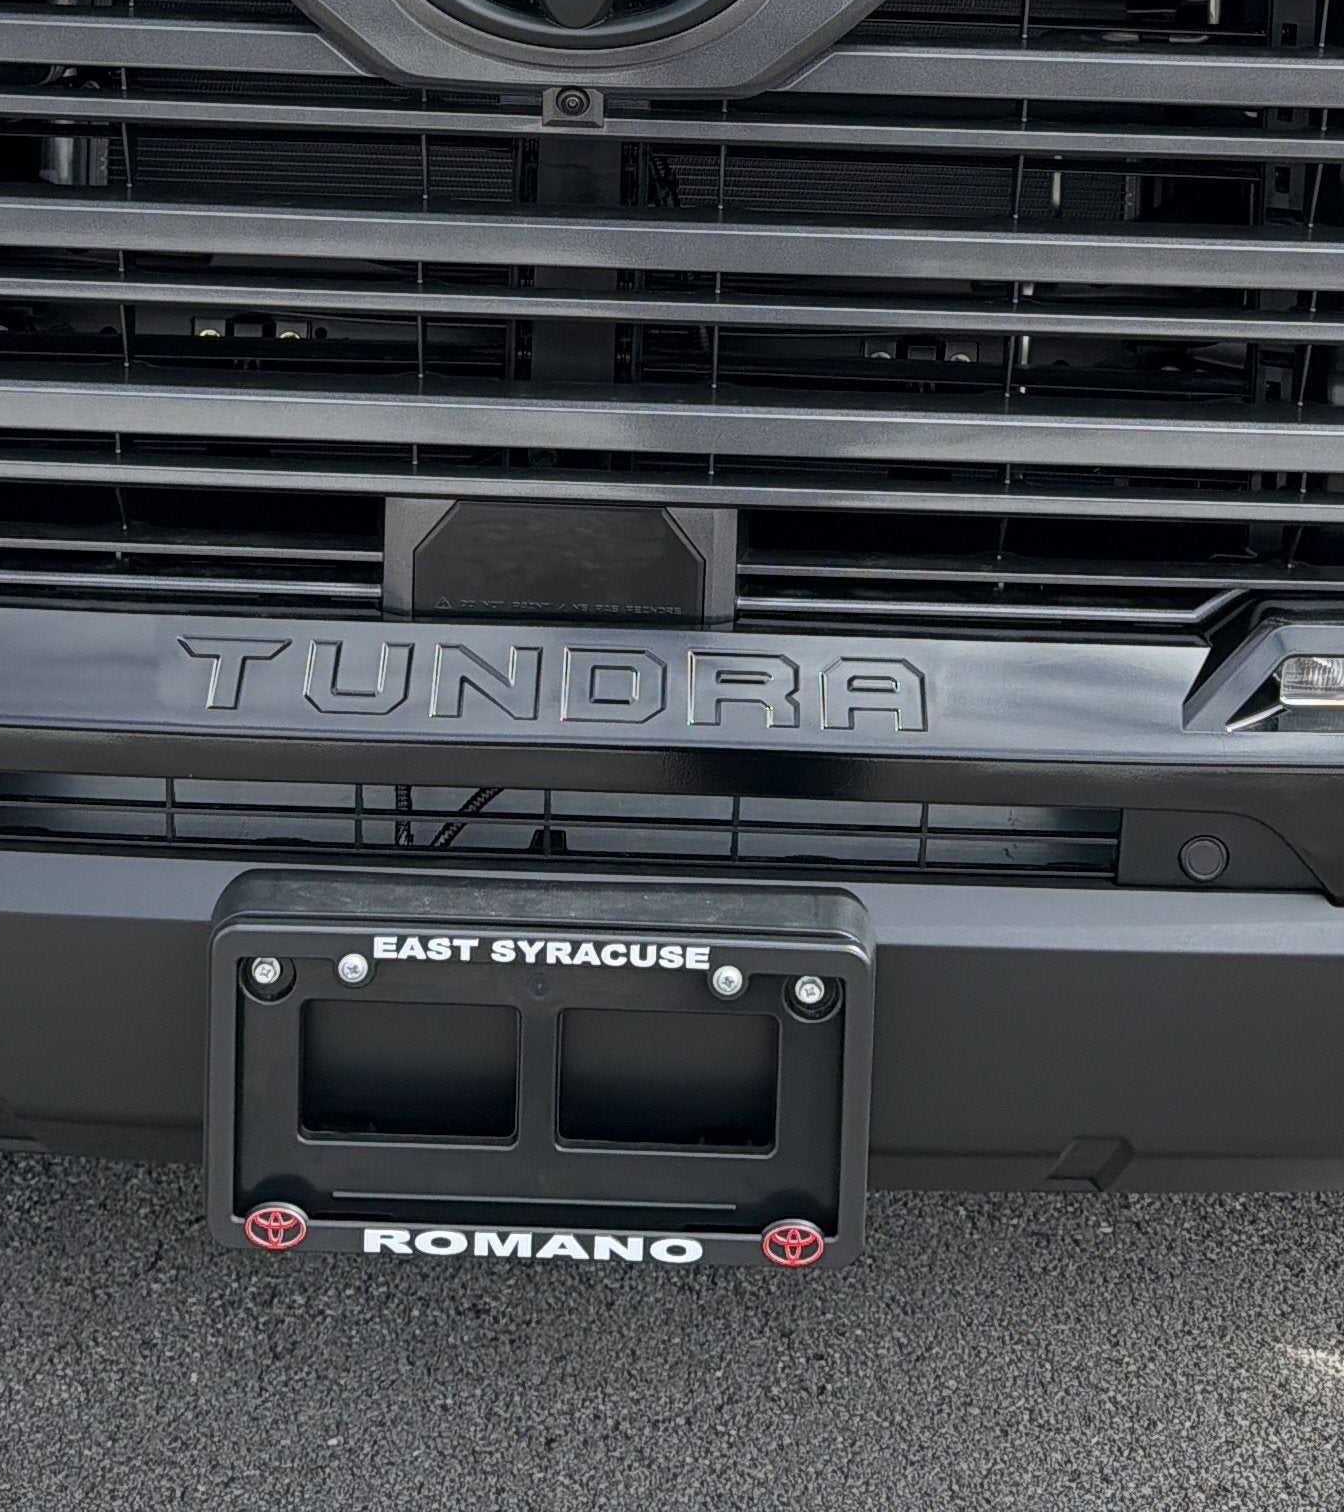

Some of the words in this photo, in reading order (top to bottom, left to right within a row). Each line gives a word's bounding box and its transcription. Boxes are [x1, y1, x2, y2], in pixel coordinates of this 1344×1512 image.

[176, 634, 930, 732] TUNDRA
[373, 935, 479, 962] EAST
[490, 939, 711, 970] SYRACUSE
[362, 1228, 704, 1264] ROMANO
